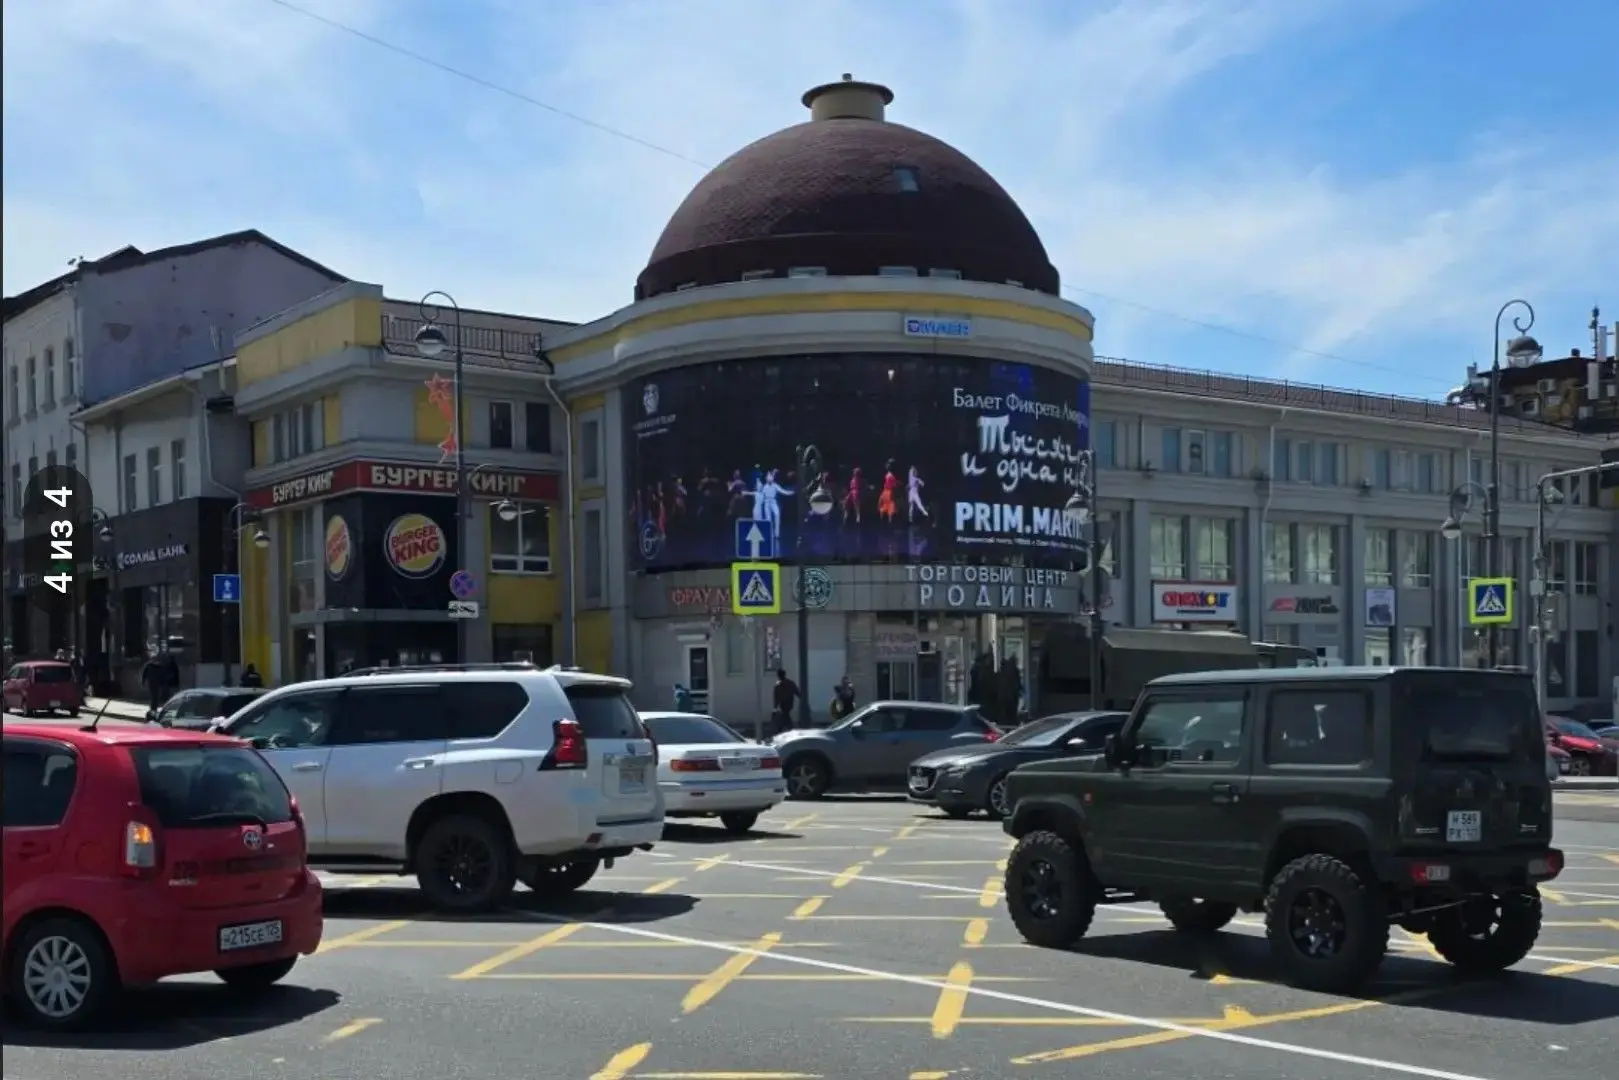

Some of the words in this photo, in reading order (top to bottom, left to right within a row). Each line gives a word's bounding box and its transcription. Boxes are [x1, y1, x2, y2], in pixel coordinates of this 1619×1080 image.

[953, 387, 1002, 410] Балет
[370, 464, 458, 489] БУРГЕР
[961, 452, 987, 476] и
[996, 459, 1057, 493] одна
[272, 477, 306, 503] БУРГЕР
[307, 470, 334, 495] КИНГ
[391, 524, 439, 549] BURGER
[395, 536, 440, 564] KING
[905, 565, 1015, 583] ТОРГОВЫЙ
[1025, 568, 1068, 586] ЦЕНТР
[672, 587, 712, 609] ФРАУ
[919, 584, 1055, 609] РОДИНА
